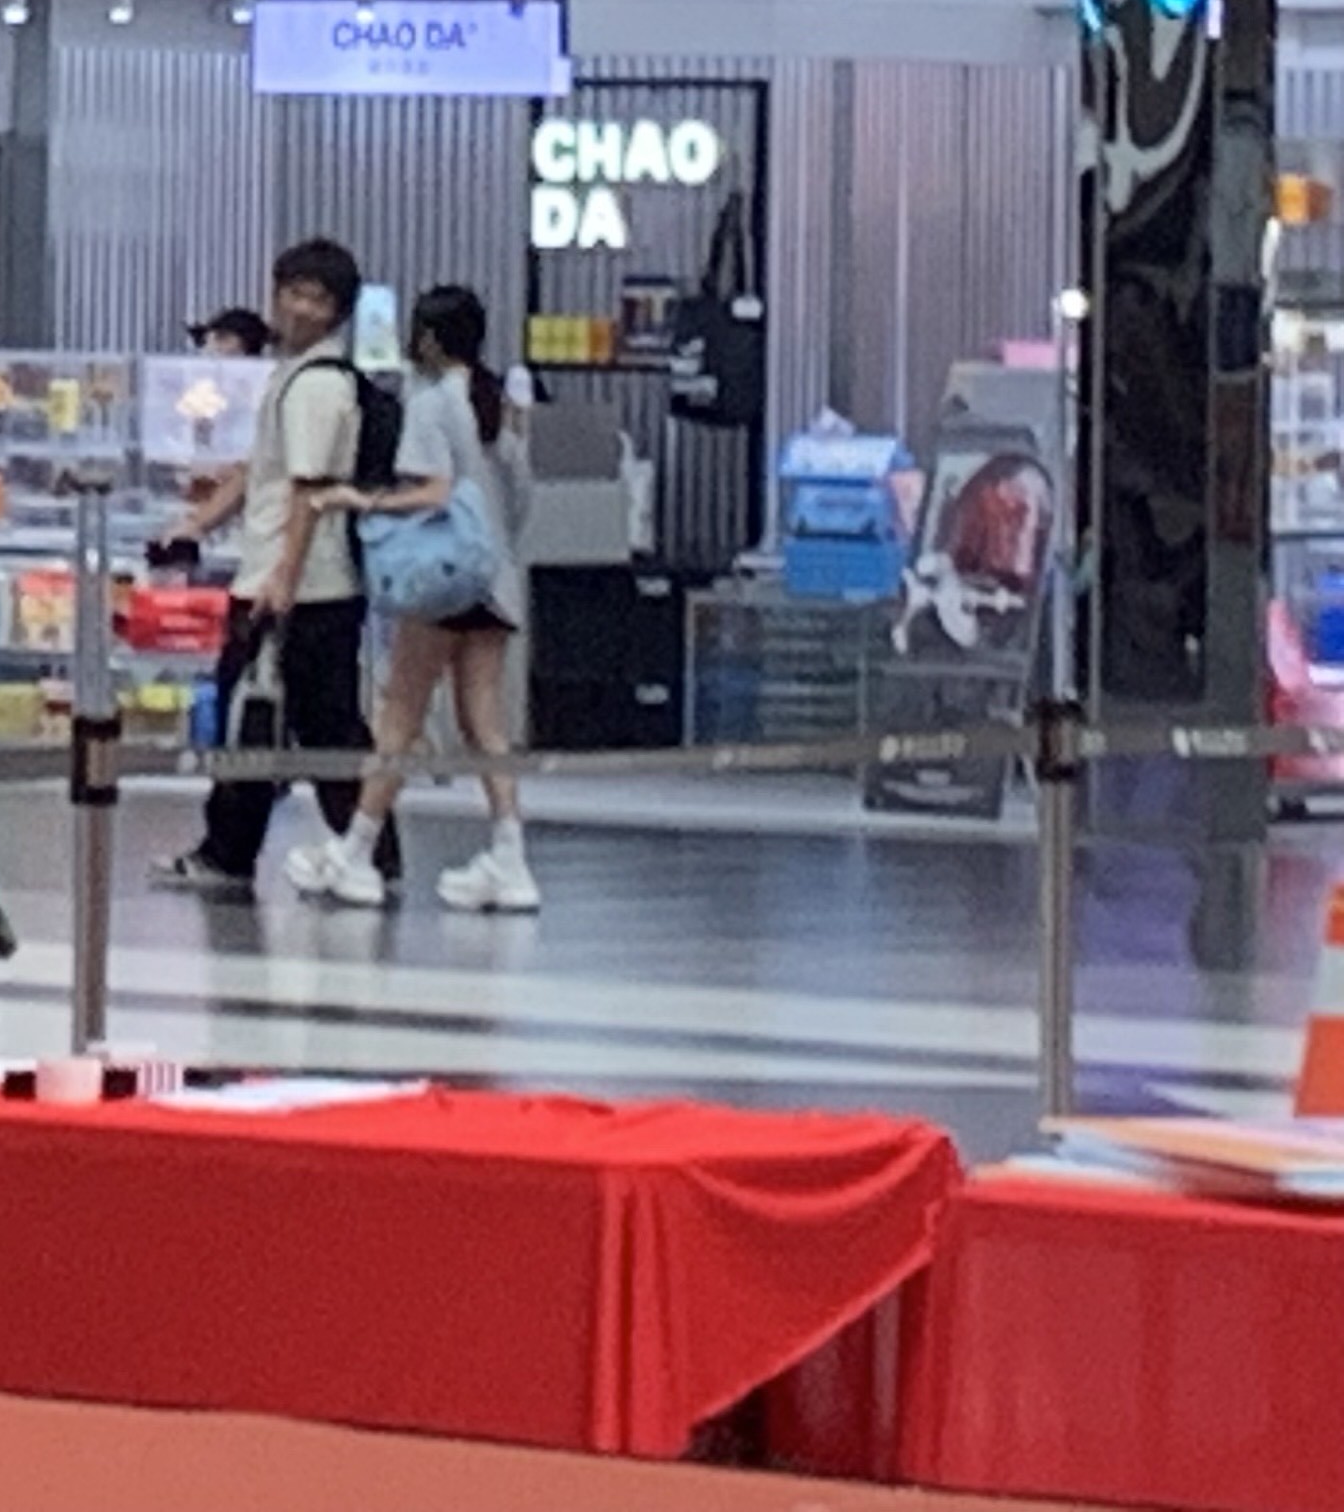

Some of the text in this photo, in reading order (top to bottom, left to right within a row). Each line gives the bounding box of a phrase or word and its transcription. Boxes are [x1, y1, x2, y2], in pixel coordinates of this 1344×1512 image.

[332, 19, 418, 50] CHAO
[531, 119, 719, 186] CHAO
[530, 187, 628, 250] DA
